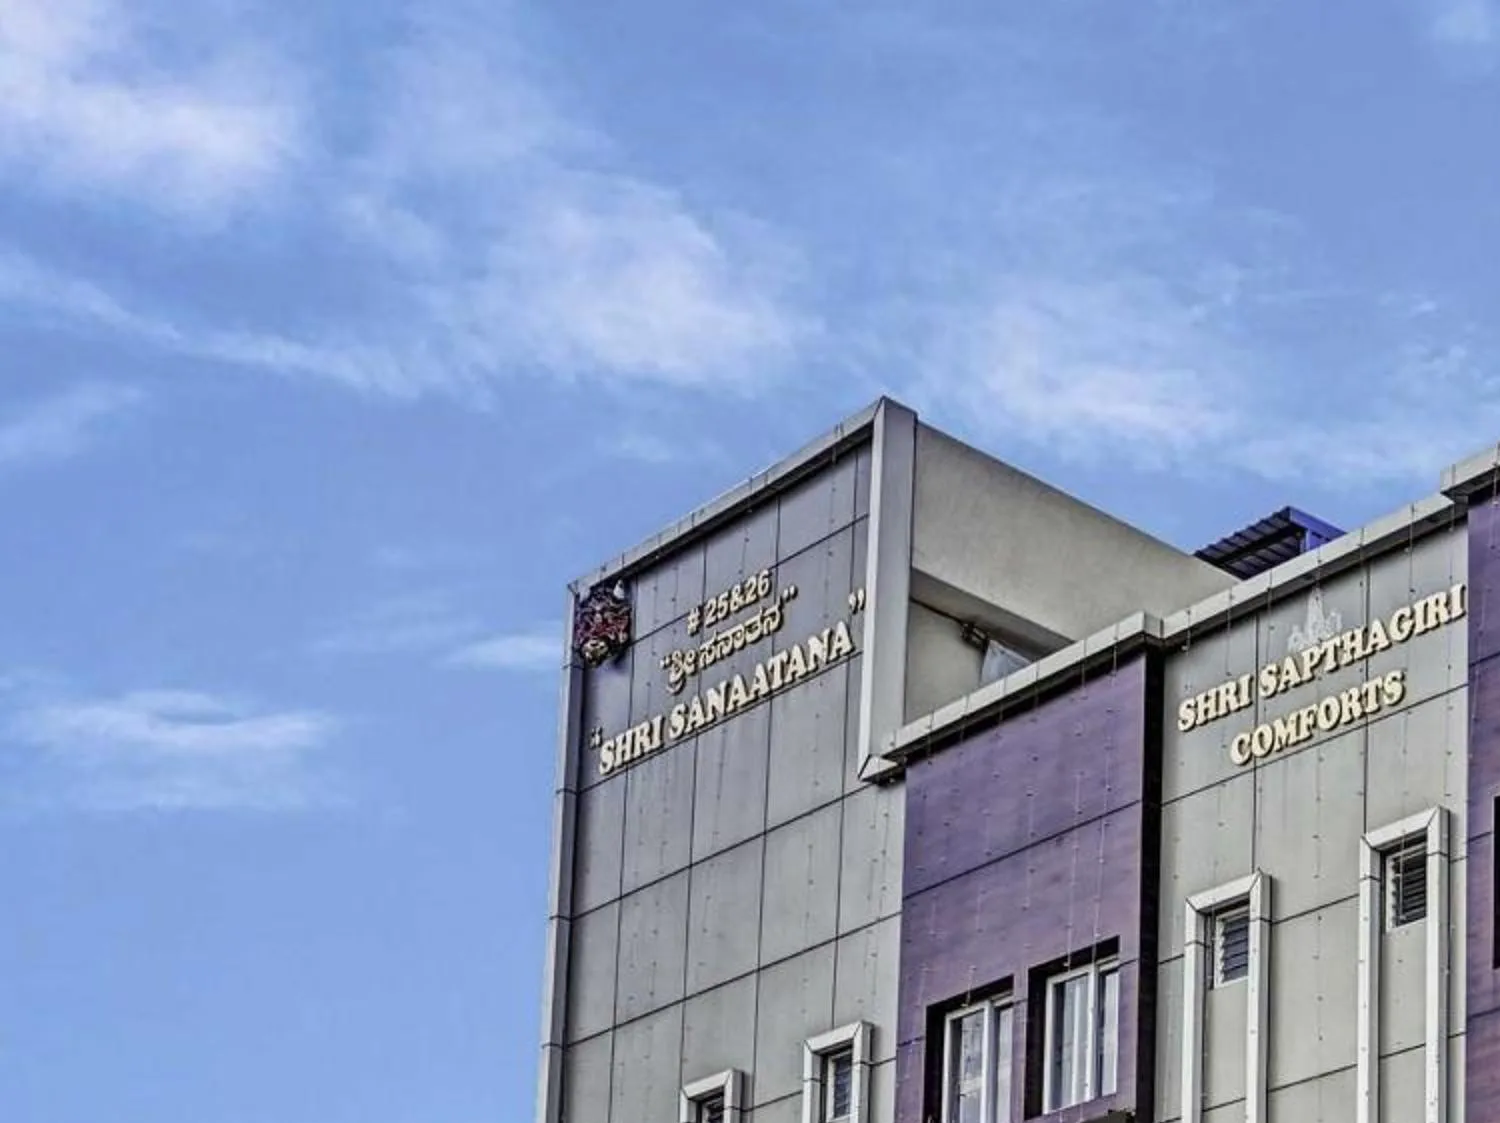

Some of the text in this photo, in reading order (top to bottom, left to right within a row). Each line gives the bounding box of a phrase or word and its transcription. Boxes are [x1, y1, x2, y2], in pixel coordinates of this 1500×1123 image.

[704, 568, 771, 627] 25&26
[1177, 583, 1467, 732] SHRI SAPTHAGIRI
[1230, 669, 1406, 765] COMFORTS
